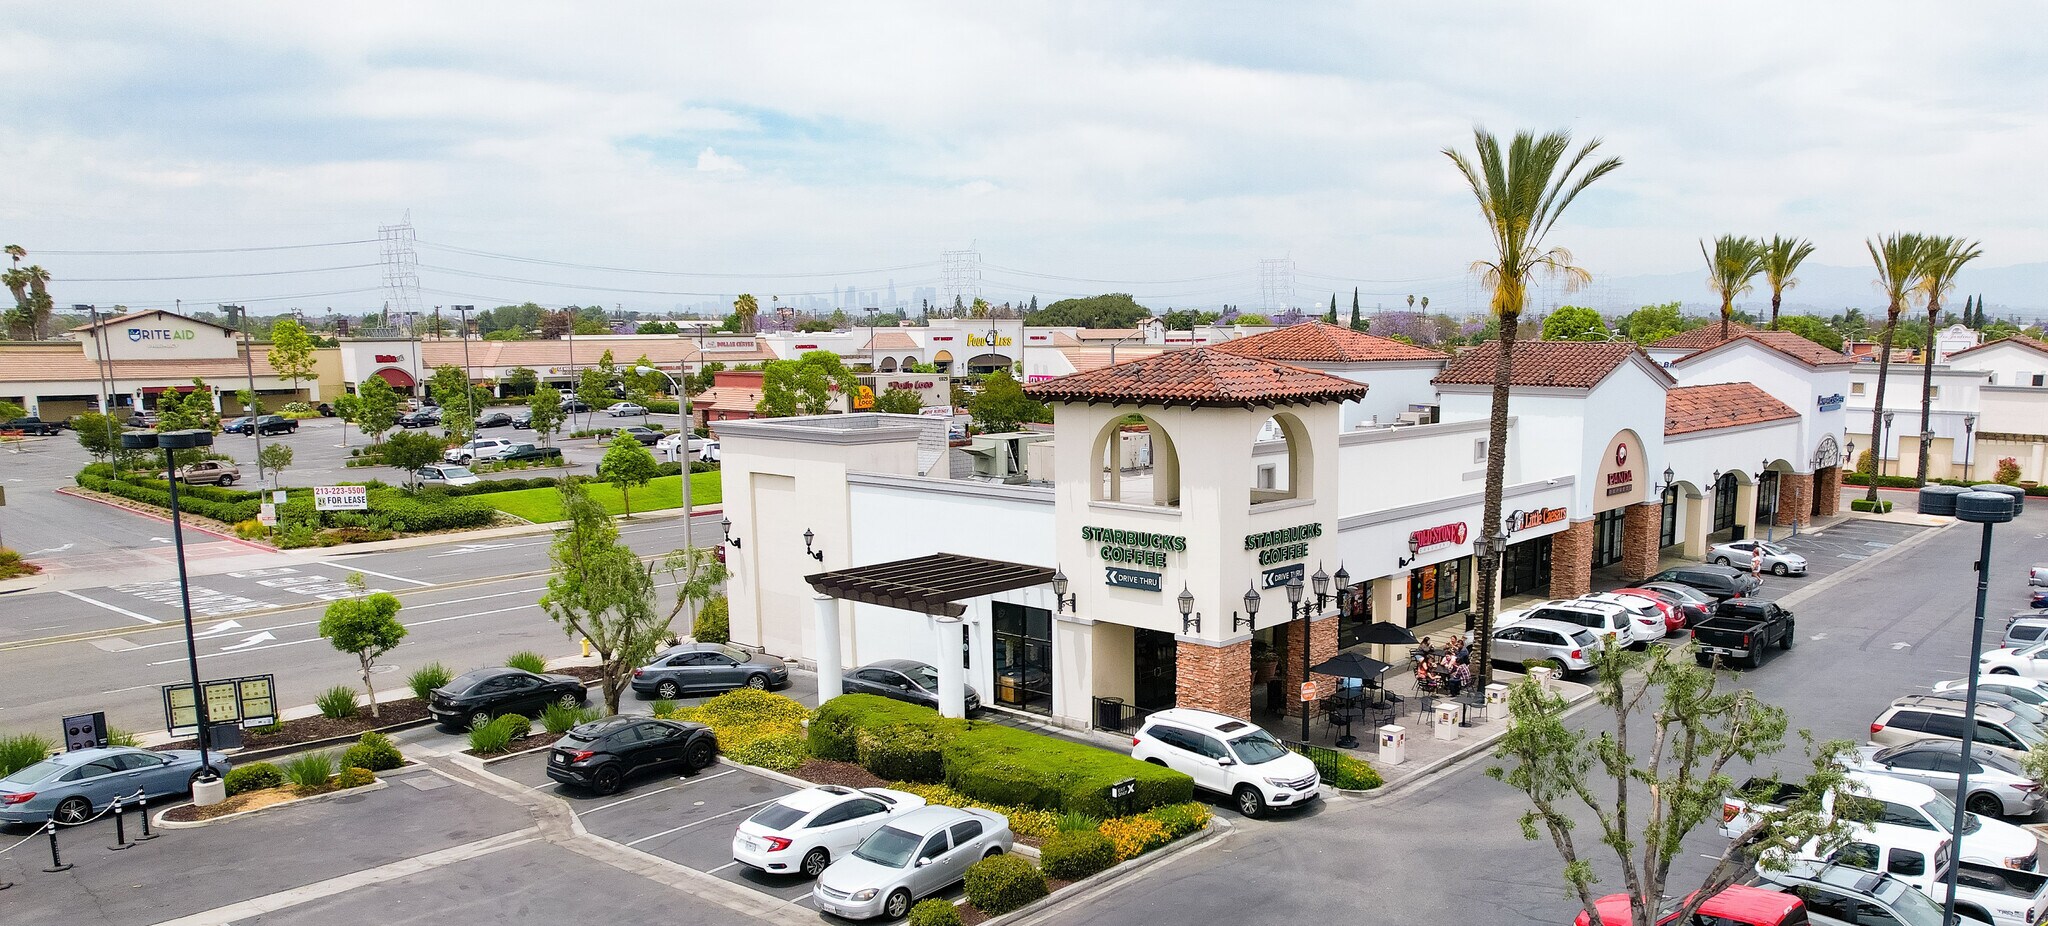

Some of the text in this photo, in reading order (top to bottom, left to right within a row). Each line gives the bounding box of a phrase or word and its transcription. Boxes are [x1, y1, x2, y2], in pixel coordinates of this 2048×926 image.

[142, 329, 195, 340] RITE AID
[967, 333, 985, 347] FOOD
[994, 334, 1012, 346] LESS
[893, 381, 913, 390] Pollo
[914, 380, 933, 389] Loco
[1607, 469, 1632, 486] PANDA
[315, 487, 365, 495] 213-223-5500
[327, 495, 366, 504] FOR LEASE
[1524, 507, 1567, 529] Little Caesars
[1081, 526, 1187, 552] STARBUCKS
[1244, 522, 1322, 551] STARBUCKS
[1100, 545, 1167, 568] COFFEE
[1259, 542, 1309, 566] COFFEE
[1118, 574, 1157, 587] DRIVE THRU
[1274, 571, 1290, 582] DRIVE
